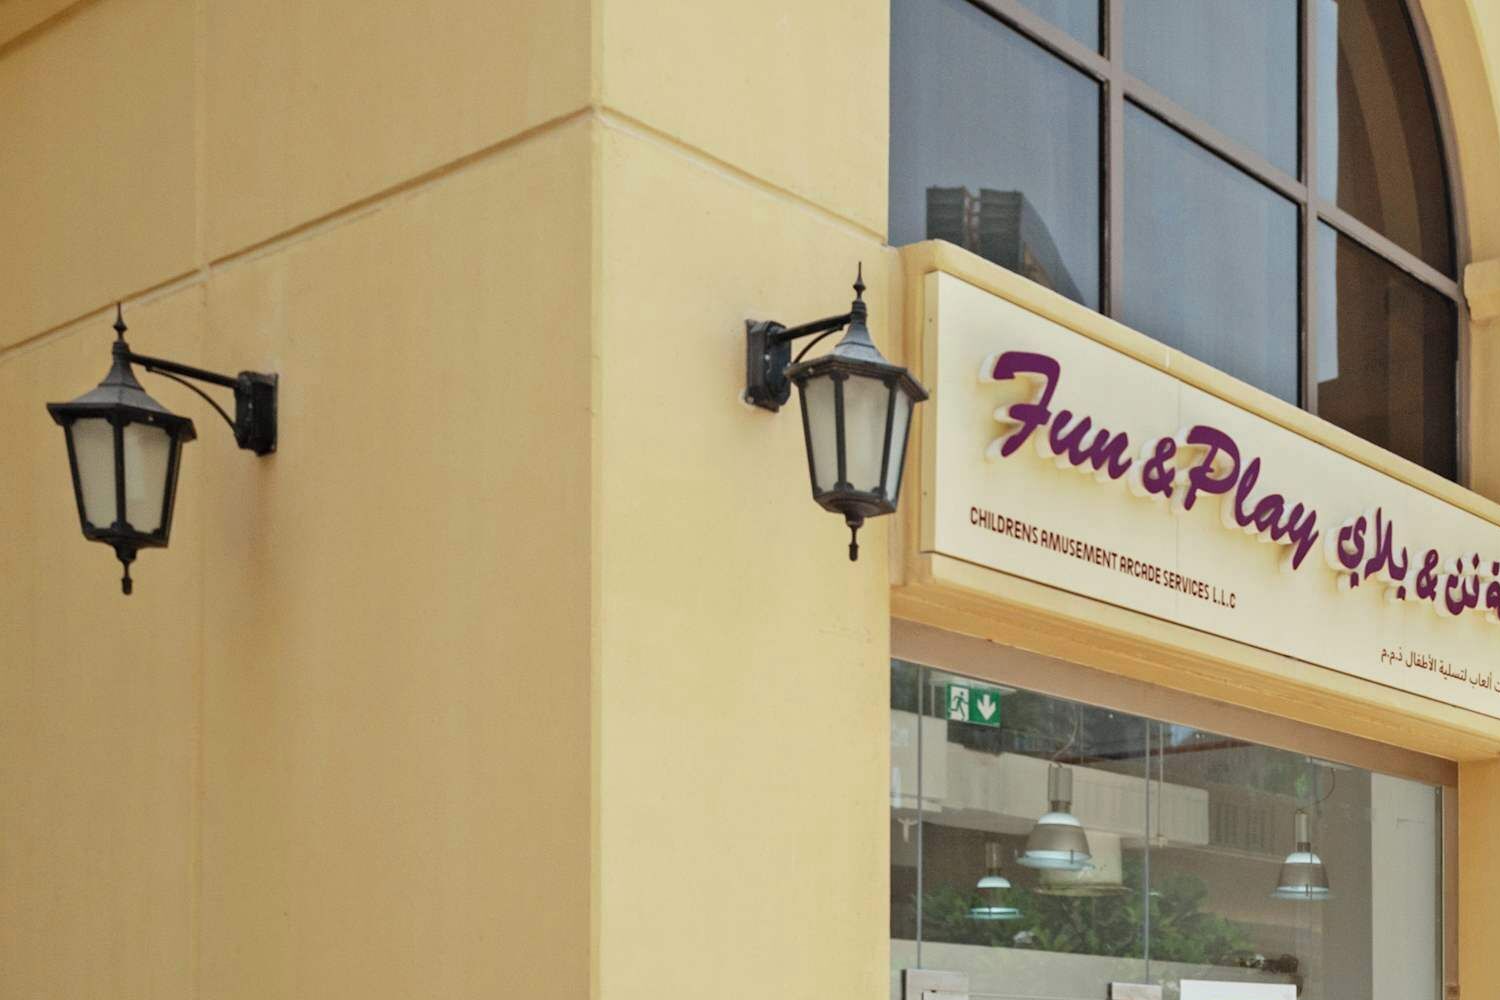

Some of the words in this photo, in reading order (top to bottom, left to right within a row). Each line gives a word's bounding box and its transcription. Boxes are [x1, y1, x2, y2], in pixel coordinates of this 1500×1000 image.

[993, 351, 1132, 480] Fun
[1142, 437, 1177, 499] &
[1186, 425, 1319, 571] Play
[970, 506, 1039, 545] CHILDRENS
[1040, 529, 1118, 572] AMUSEMENT
[1119, 555, 1161, 586] ARCADE
[1163, 569, 1210, 602] SERVICES
[1212, 586, 1237, 609] L.L.C
[1337, 506, 1408, 601] بلاي
[1415, 548, 1439, 601] &
[1445, 552, 1480, 616] فن
[1405, 650, 1437, 673] الأطفال
[1439, 658, 1467, 682] لتسلية
